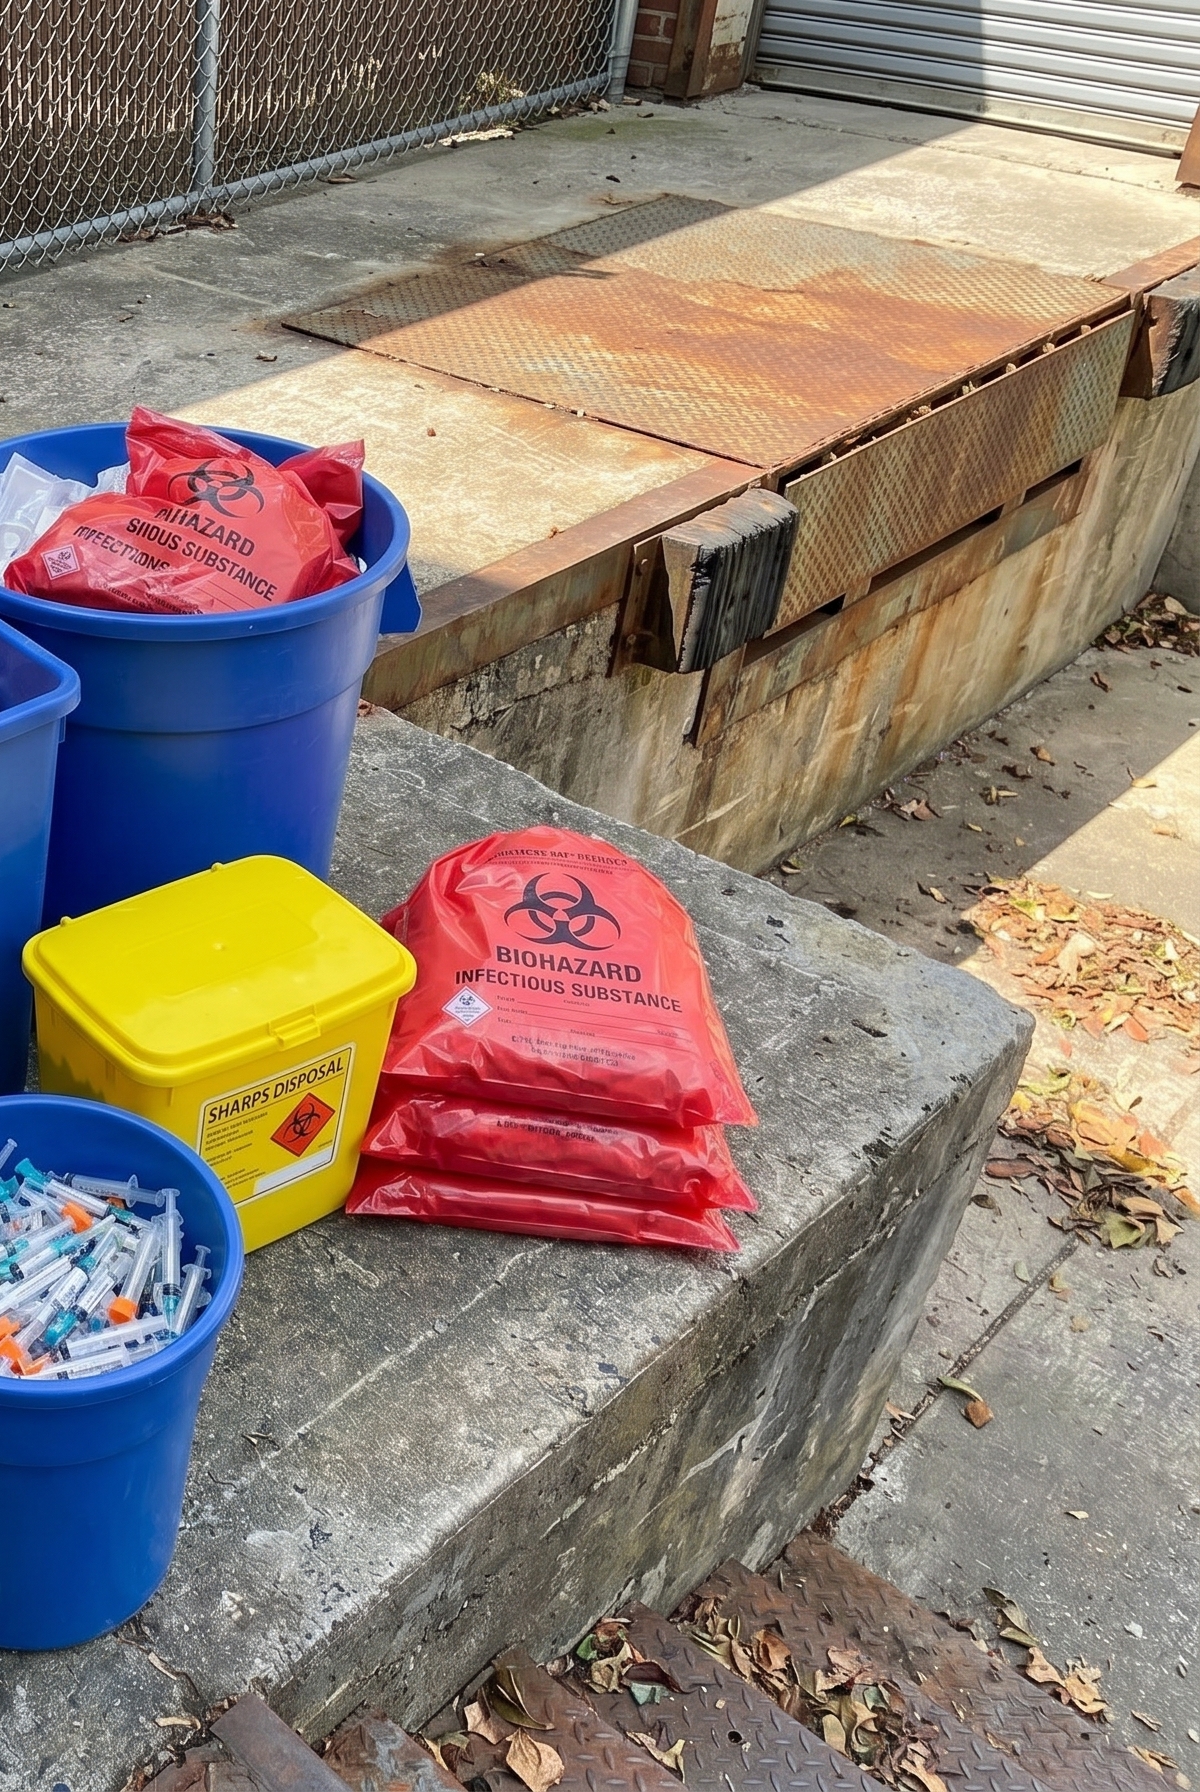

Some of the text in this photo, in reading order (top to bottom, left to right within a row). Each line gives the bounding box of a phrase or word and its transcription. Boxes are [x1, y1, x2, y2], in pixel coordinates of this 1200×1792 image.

[182, 541, 278, 602] SUBSTANCE
[455, 968, 684, 1013] INFECTIOUS SUBSTANCE
[496, 945, 642, 983] BIOHAZARD
[208, 1057, 344, 1124] SHARPS DISPOSAL
